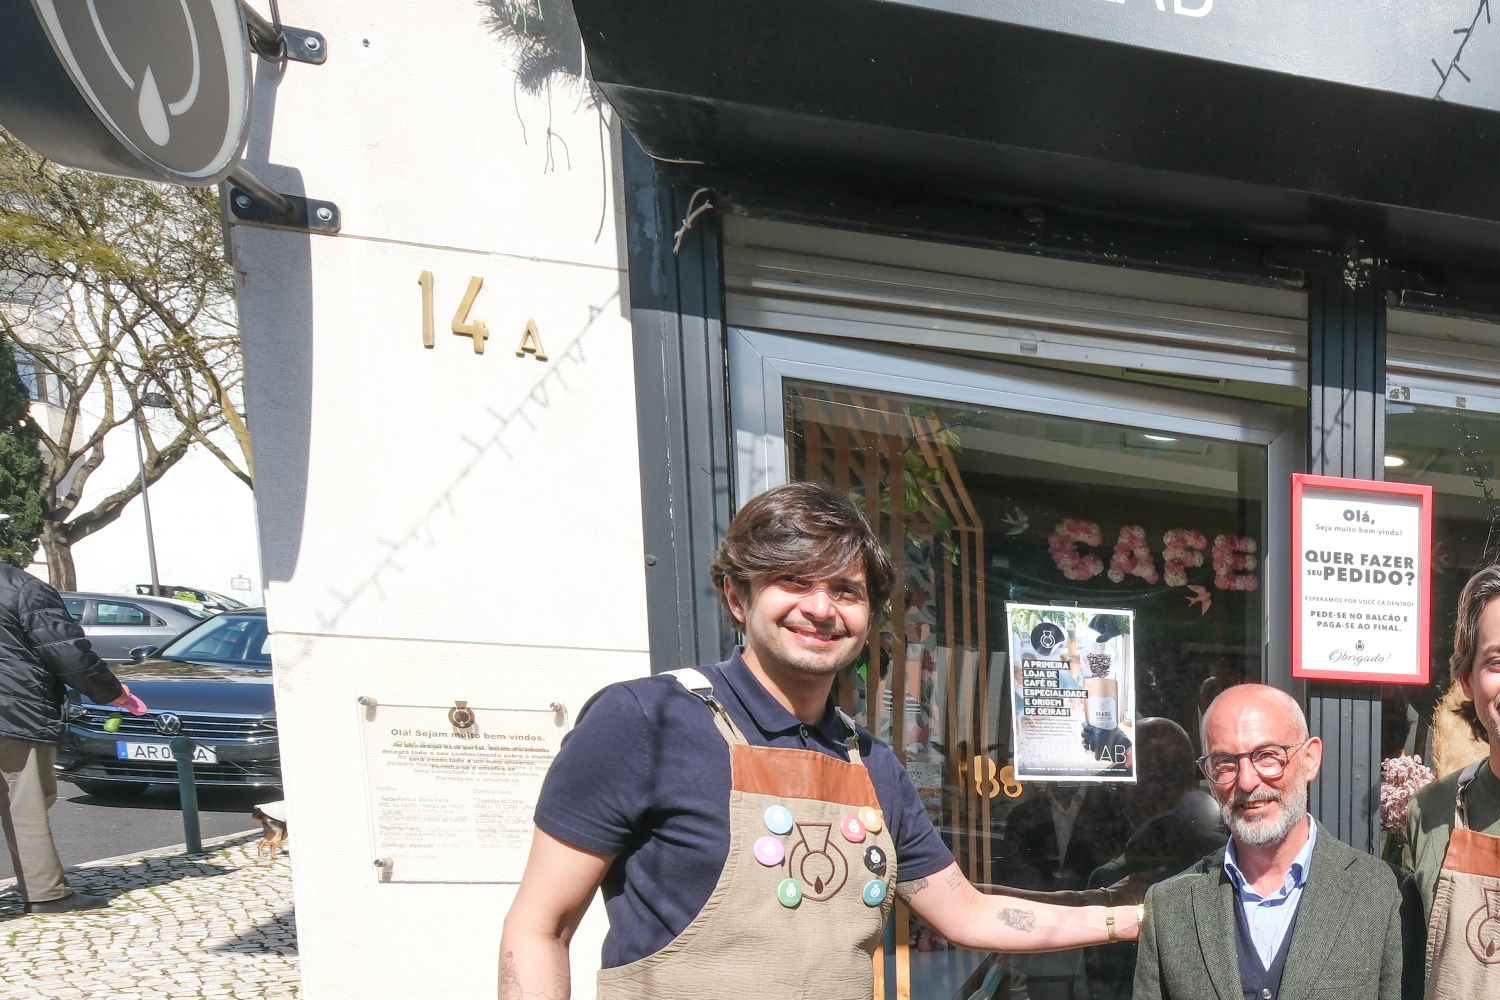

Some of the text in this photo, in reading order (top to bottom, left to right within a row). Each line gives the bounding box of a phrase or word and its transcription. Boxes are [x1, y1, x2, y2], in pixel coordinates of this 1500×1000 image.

[418, 270, 548, 362] 14 A
[1343, 509, 1375, 524] Olá,
[1316, 524, 1332, 532] Seja
[1359, 527, 1403, 536] bem-vindo!
[1048, 518, 1258, 591] CAFE
[1305, 550, 1414, 569] QUER FAZER
[1323, 566, 1415, 586] PEDIDO?
[1310, 611, 1346, 619] PEDE-SE
[1366, 613, 1401, 622] BALCÃO
[1317, 621, 1355, 630] PAGA-SE
[1373, 624, 1401, 632] FINAL.
[1328, 650, 1392, 666] Obrigado!
[1031, 661, 1069, 670] PRIMEIRA
[1023, 670, 1045, 678] LOJA
[1024, 679, 1057, 688] CAFÉ DE
[1024, 689, 1087, 698] ESPECIALIDADE
[1037, 708, 1070, 716] OEIRAS!
[415, 729, 447, 739] Sejam
[451, 730, 480, 739] muito
